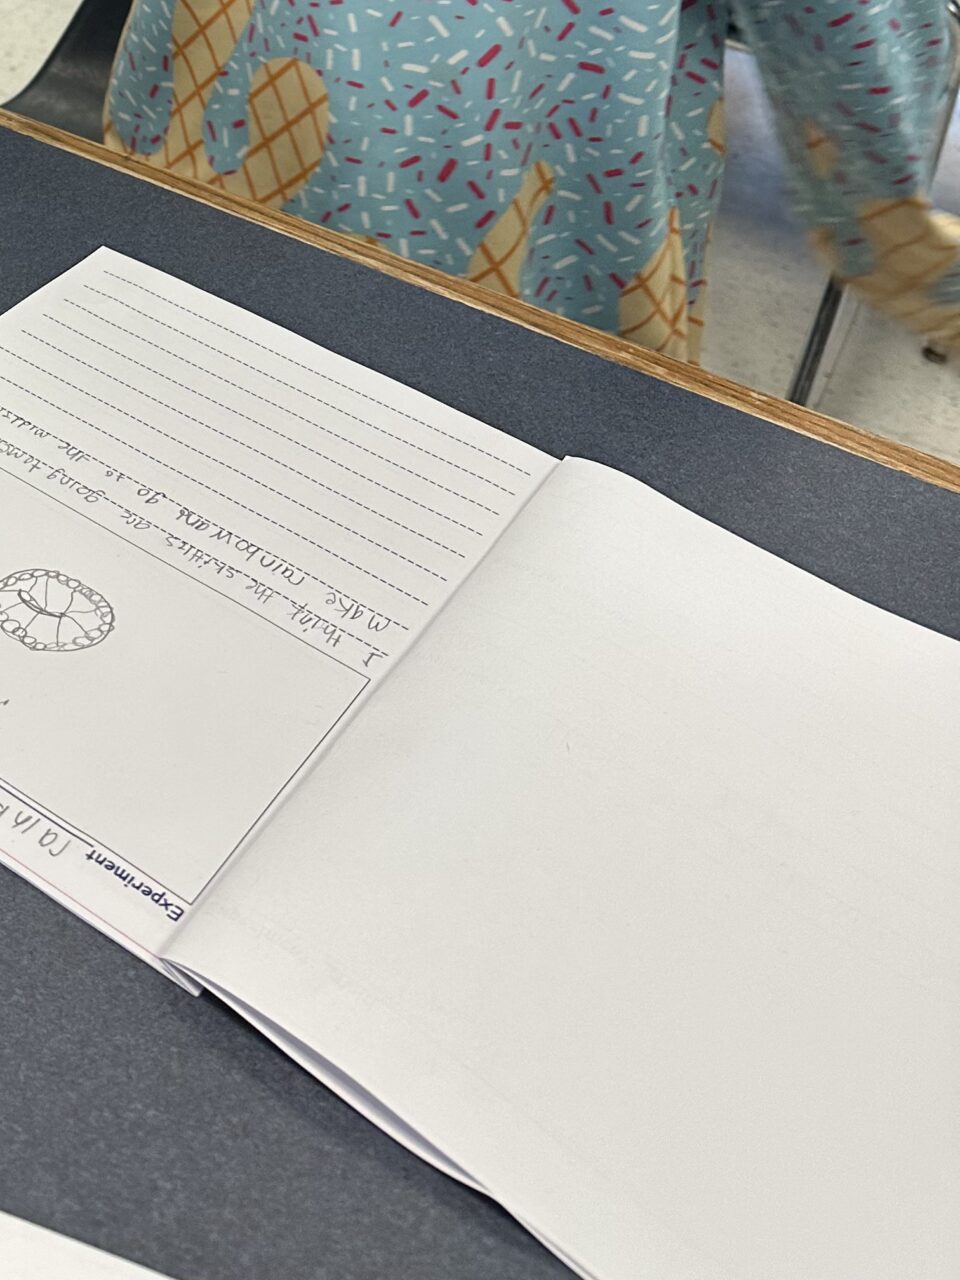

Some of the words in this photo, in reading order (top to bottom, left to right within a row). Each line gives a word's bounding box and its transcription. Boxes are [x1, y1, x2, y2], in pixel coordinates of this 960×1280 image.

[57, 441, 92, 463] the
[46, 468, 106, 503] going
[137, 486, 167, 505] go
[245, 576, 273, 604] the
[85, 847, 185, 923] Experiment
